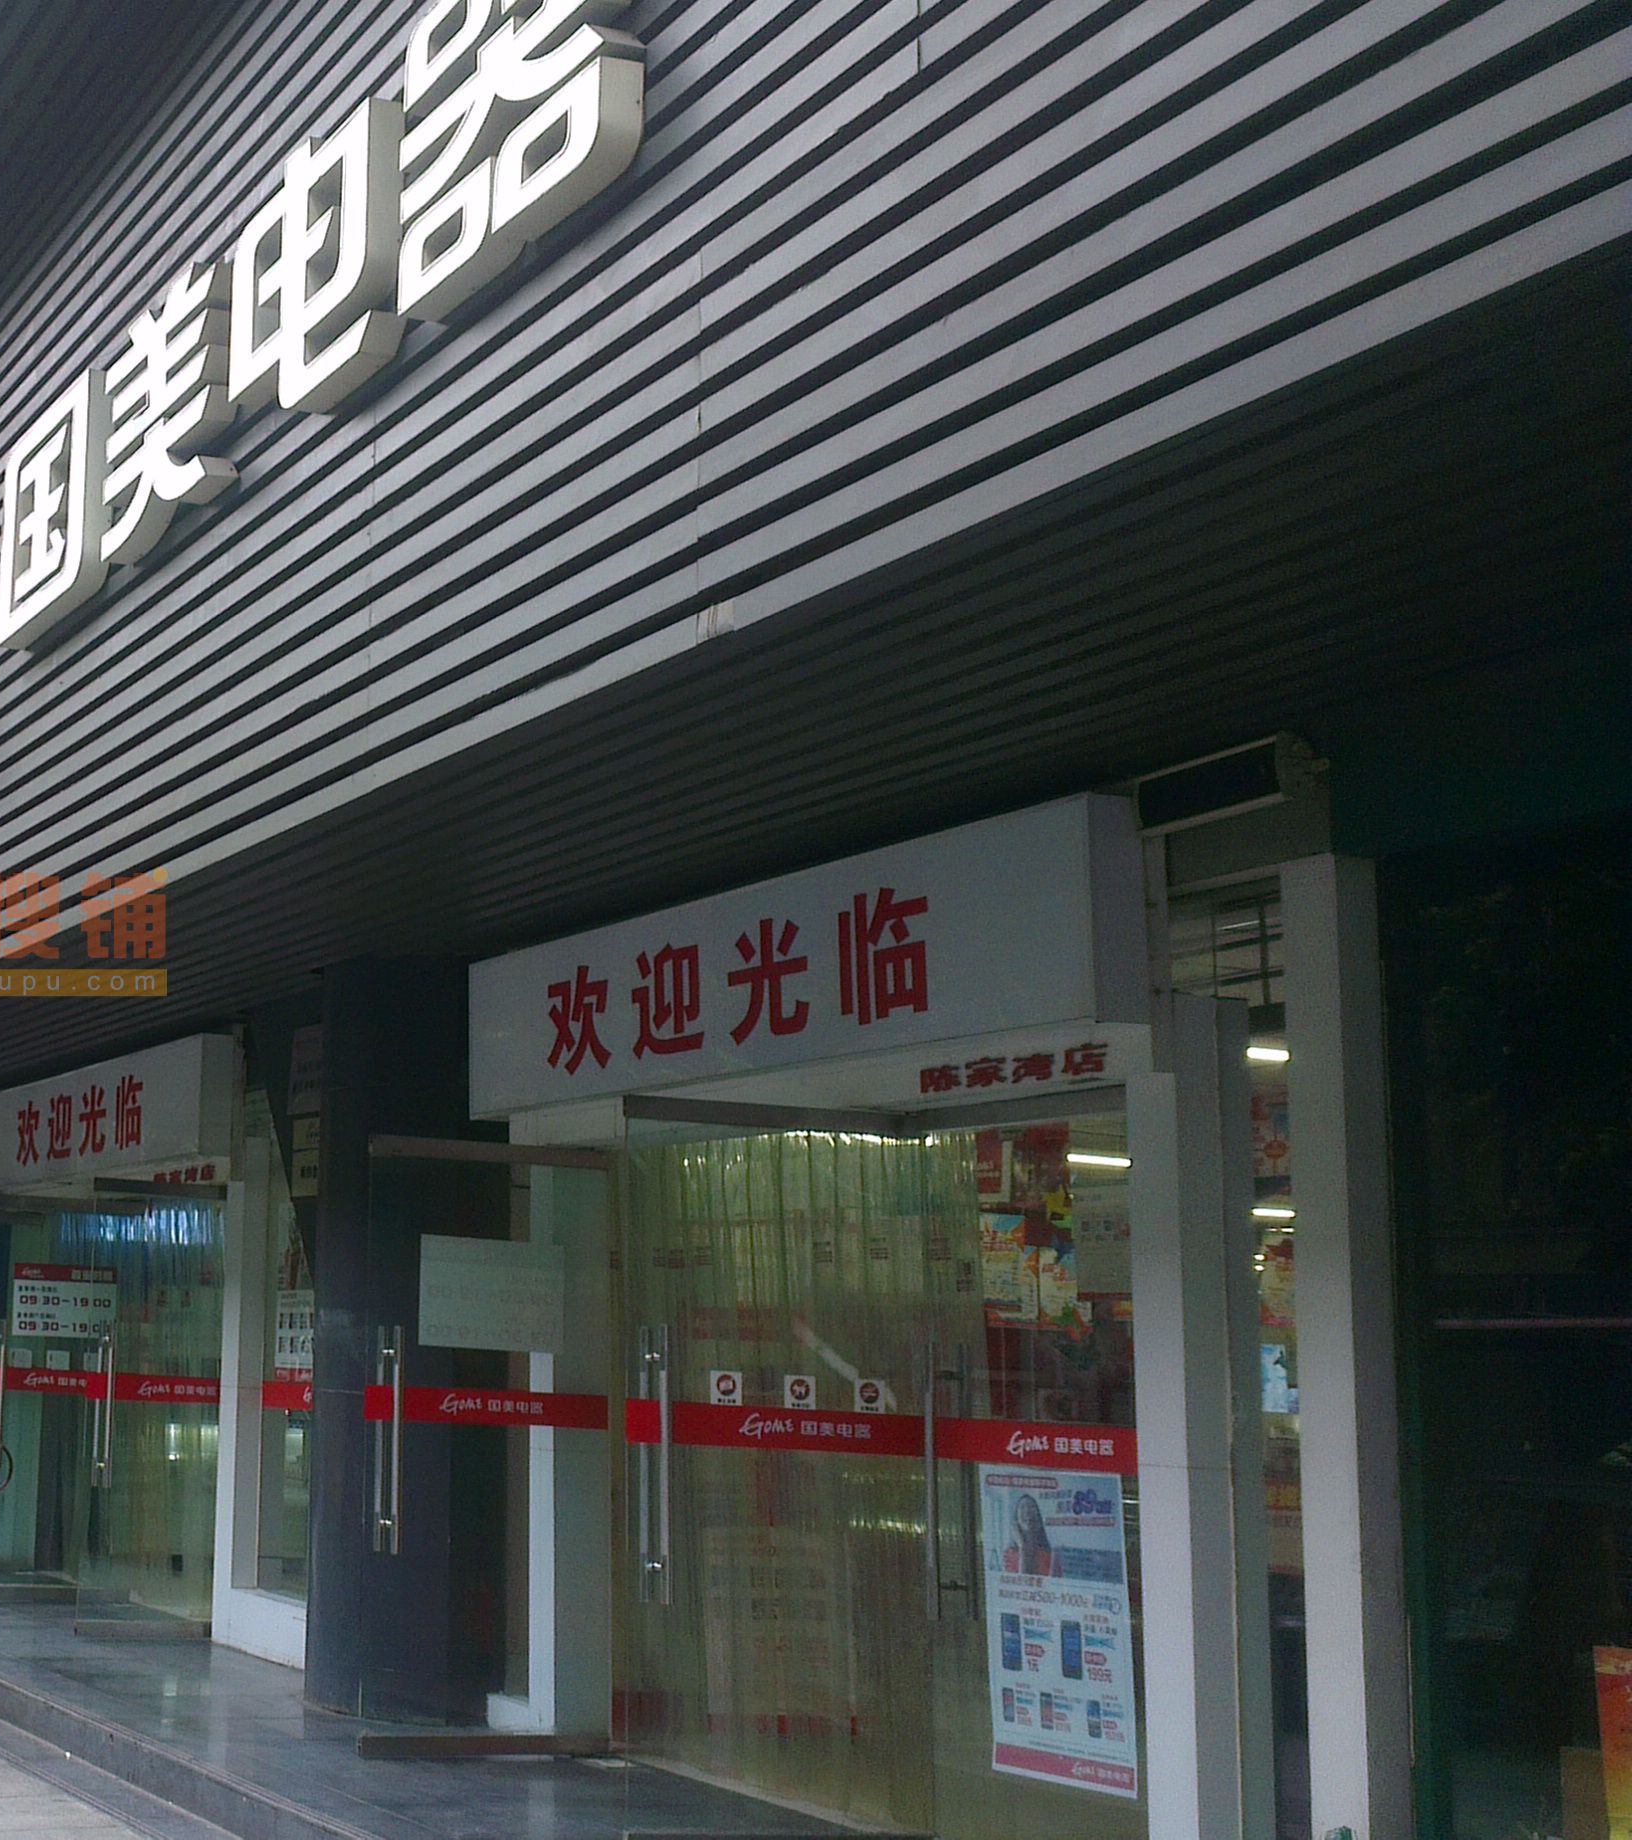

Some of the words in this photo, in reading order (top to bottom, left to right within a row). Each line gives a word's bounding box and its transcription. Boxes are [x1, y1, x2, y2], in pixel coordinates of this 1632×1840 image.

[546, 887, 930, 1075] 欢迎光临
[919, 1043, 1109, 1094] 陈家湾店
[16, 1074, 144, 1168] 欢迎光临
[58, 1377, 88, 1388] 国美电
[487, 1398, 544, 1415] 国美电器
[800, 1420, 872, 1440] 国美电器
[1053, 1437, 1115, 1456] 国美电器
